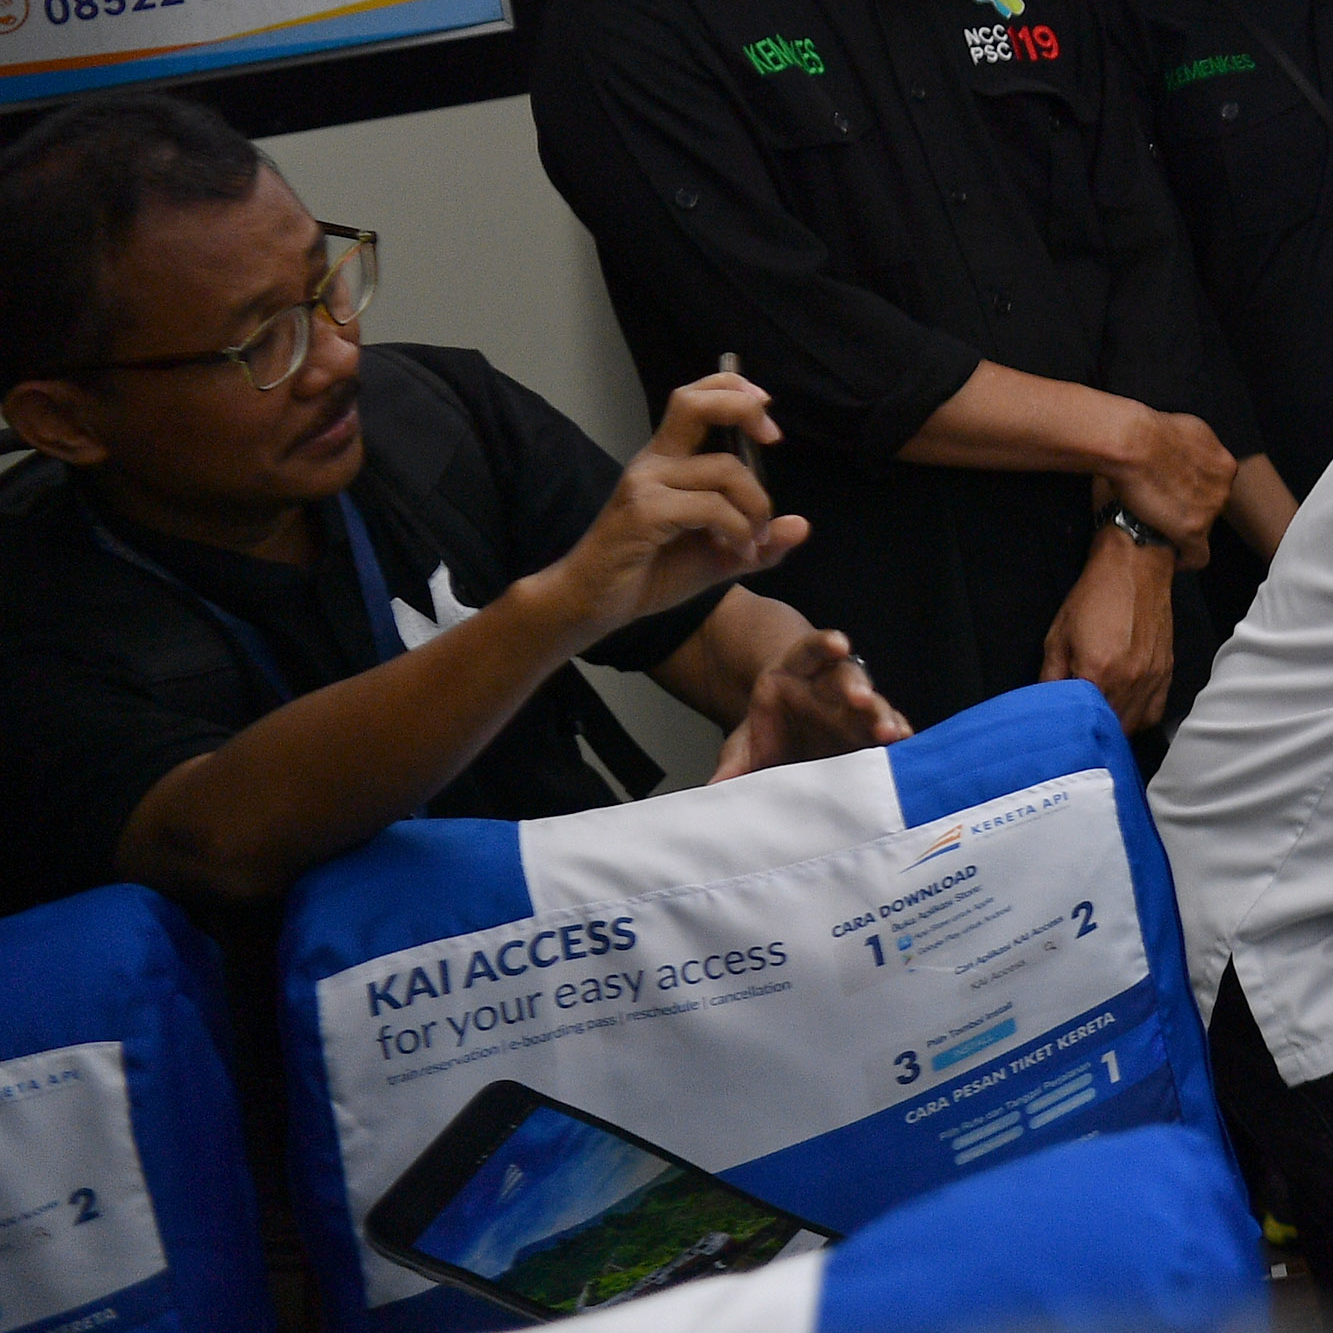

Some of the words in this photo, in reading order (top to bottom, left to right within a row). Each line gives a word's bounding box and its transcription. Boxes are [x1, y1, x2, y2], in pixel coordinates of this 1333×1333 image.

[964, 23, 1008, 46] NCC
[970, 42, 1014, 66] PSC
[1008, 24, 1062, 63] 119
[970, 804, 1038, 836] KERETA
[1042, 791, 1070, 810] API
[832, 912, 876, 939] CARA
[881, 864, 978, 919] DOWNLOAD
[1071, 899, 1099, 940] 2
[365, 959, 454, 1018] KAI
[463, 915, 638, 990] ACCESS
[864, 932, 887, 967] 1
[376, 1020, 438, 1061] for
[446, 991, 543, 1048] your
[553, 968, 645, 1010] easy
[656, 940, 787, 991] access
[508, 1022, 586, 1051] e-boarding
[626, 1000, 700, 1022] reschedule
[709, 979, 792, 1008] cancellation
[894, 1050, 921, 1085] 3
[905, 1096, 950, 1124] CARA
[953, 1068, 1006, 1103] PESAN
[1009, 1043, 1053, 1075] TIKET
[1057, 1012, 1117, 1050] KERETA
[1100, 1050, 1122, 1085] 1
[66, 1186, 103, 1228] 2
